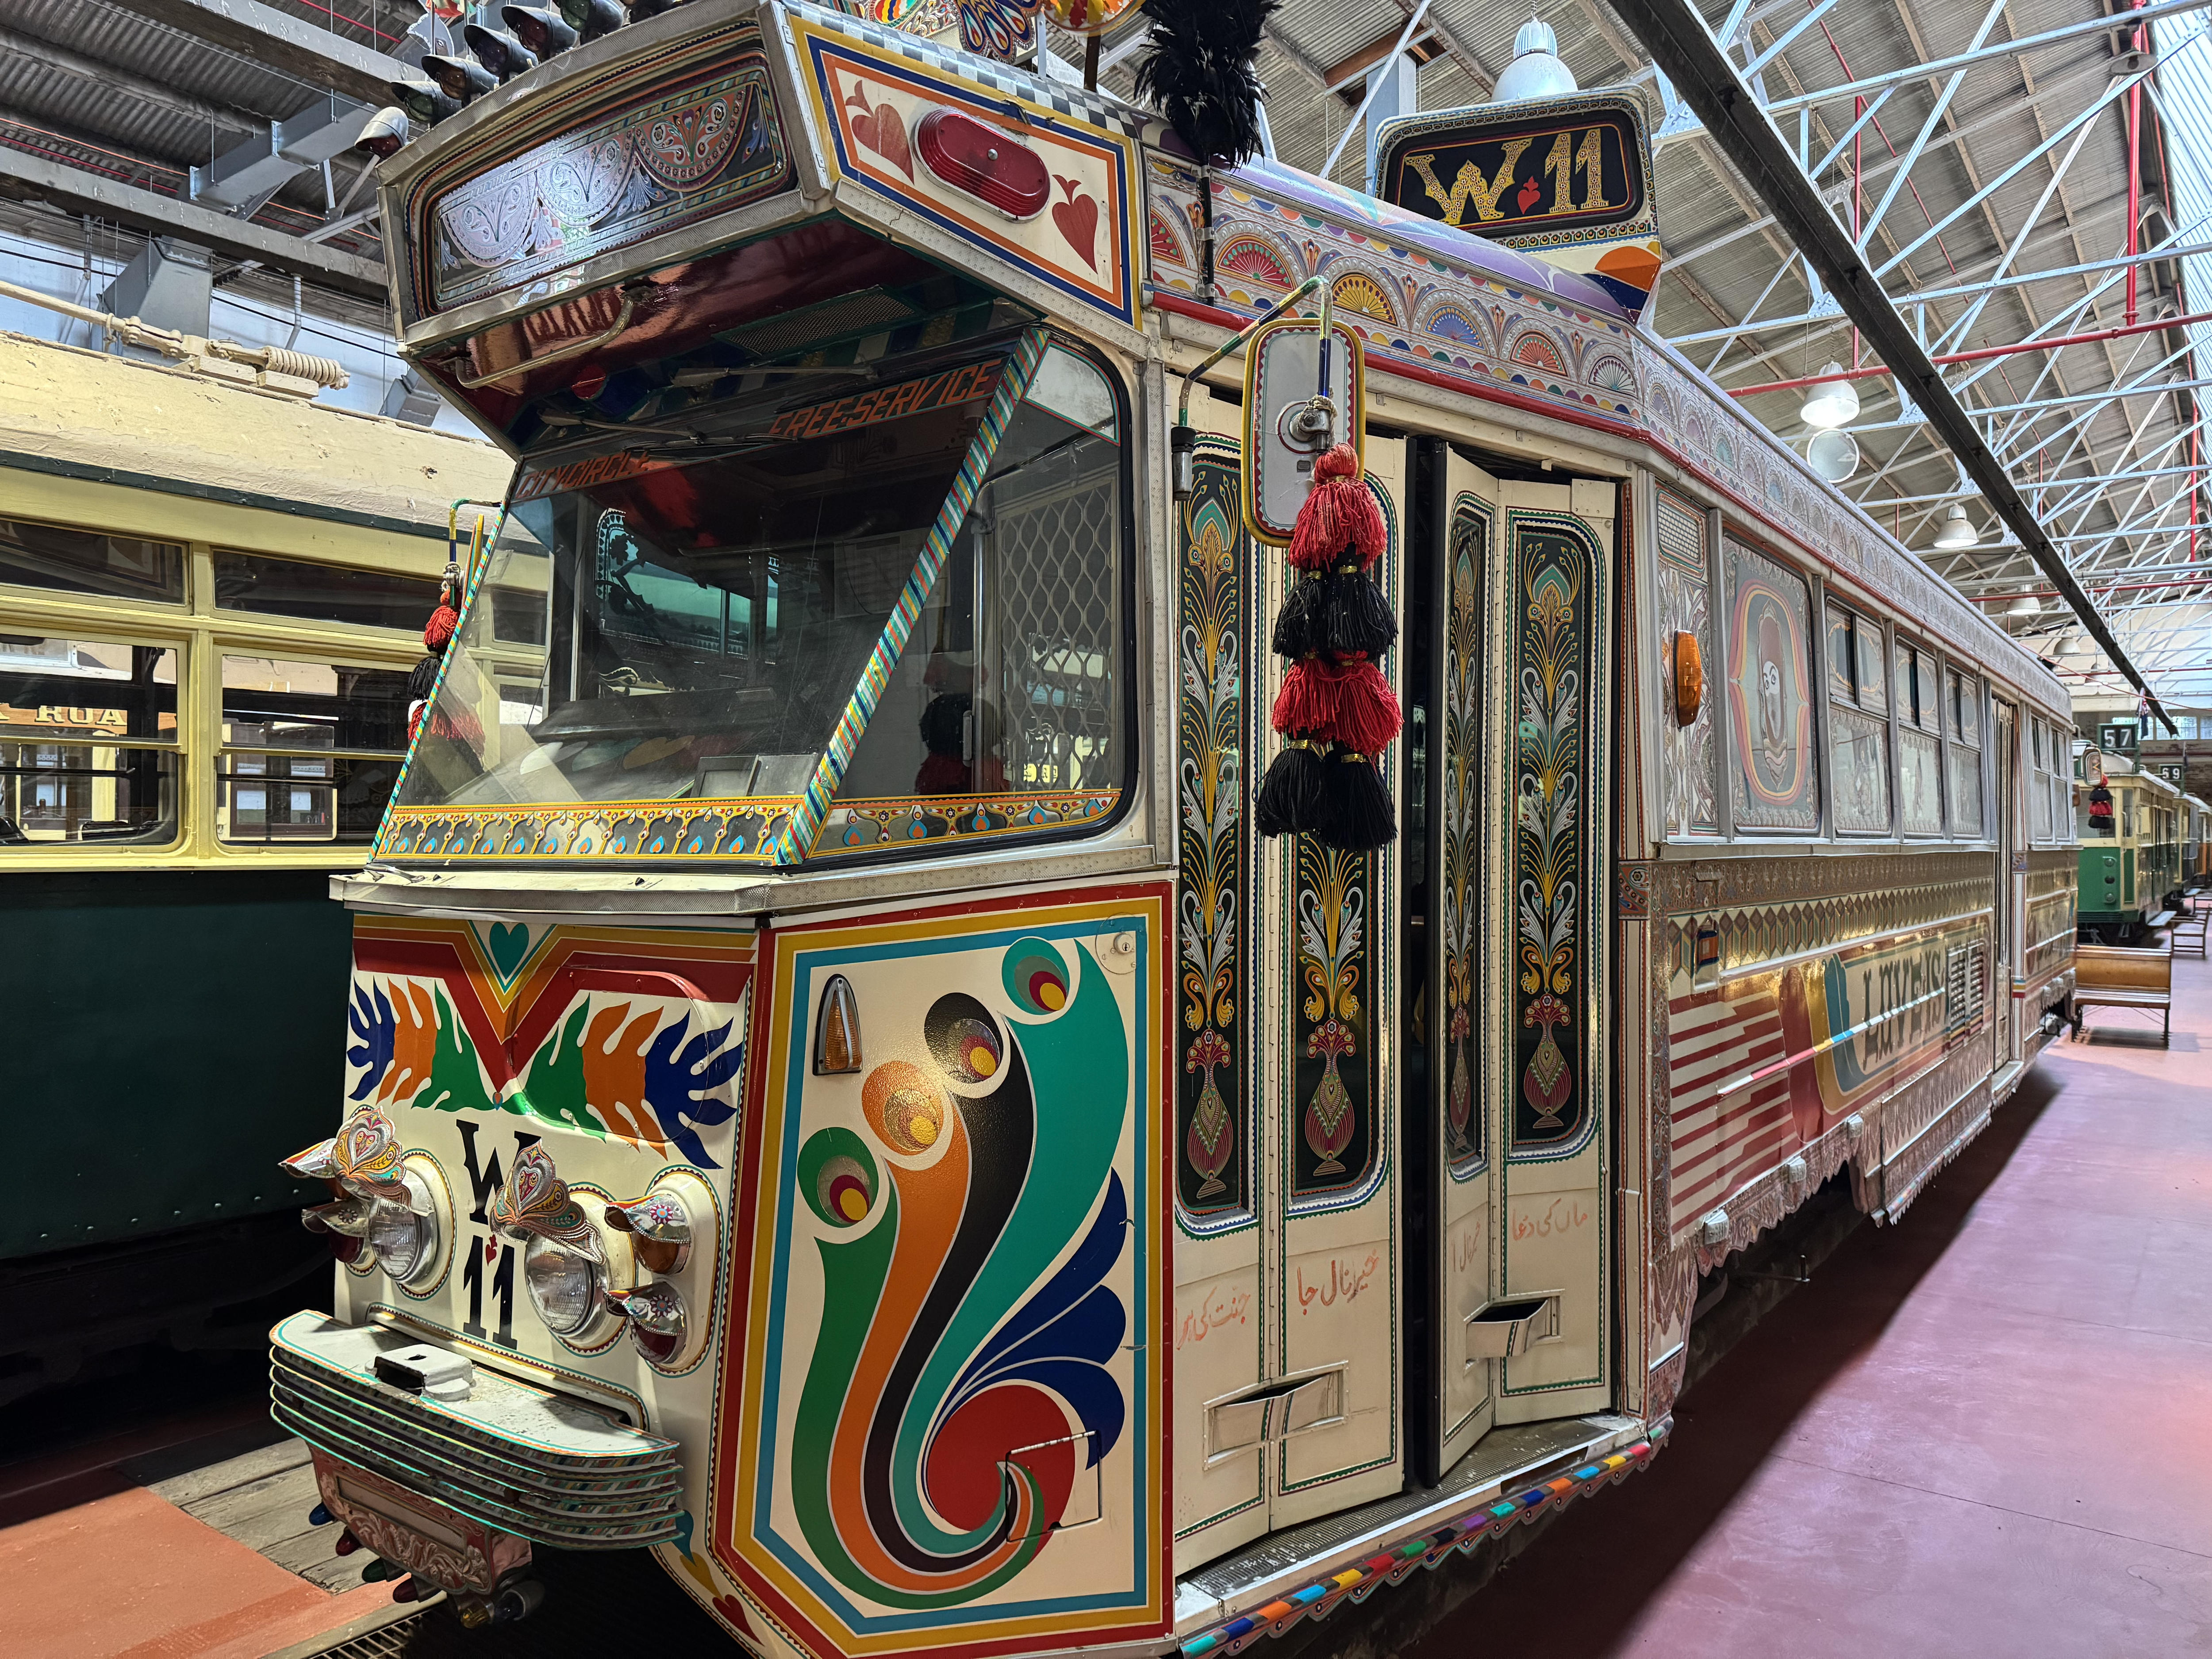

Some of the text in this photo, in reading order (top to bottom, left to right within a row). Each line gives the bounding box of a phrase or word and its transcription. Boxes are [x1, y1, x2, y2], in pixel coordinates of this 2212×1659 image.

[1405, 128, 1609, 225] W 11
[35, 705, 127, 726] ROA
[2104, 728, 2132, 748] 57
[1863, 953, 1923, 1071] LOVE
[456, 1119, 541, 1225] W
[463, 1235, 518, 1350] 11
